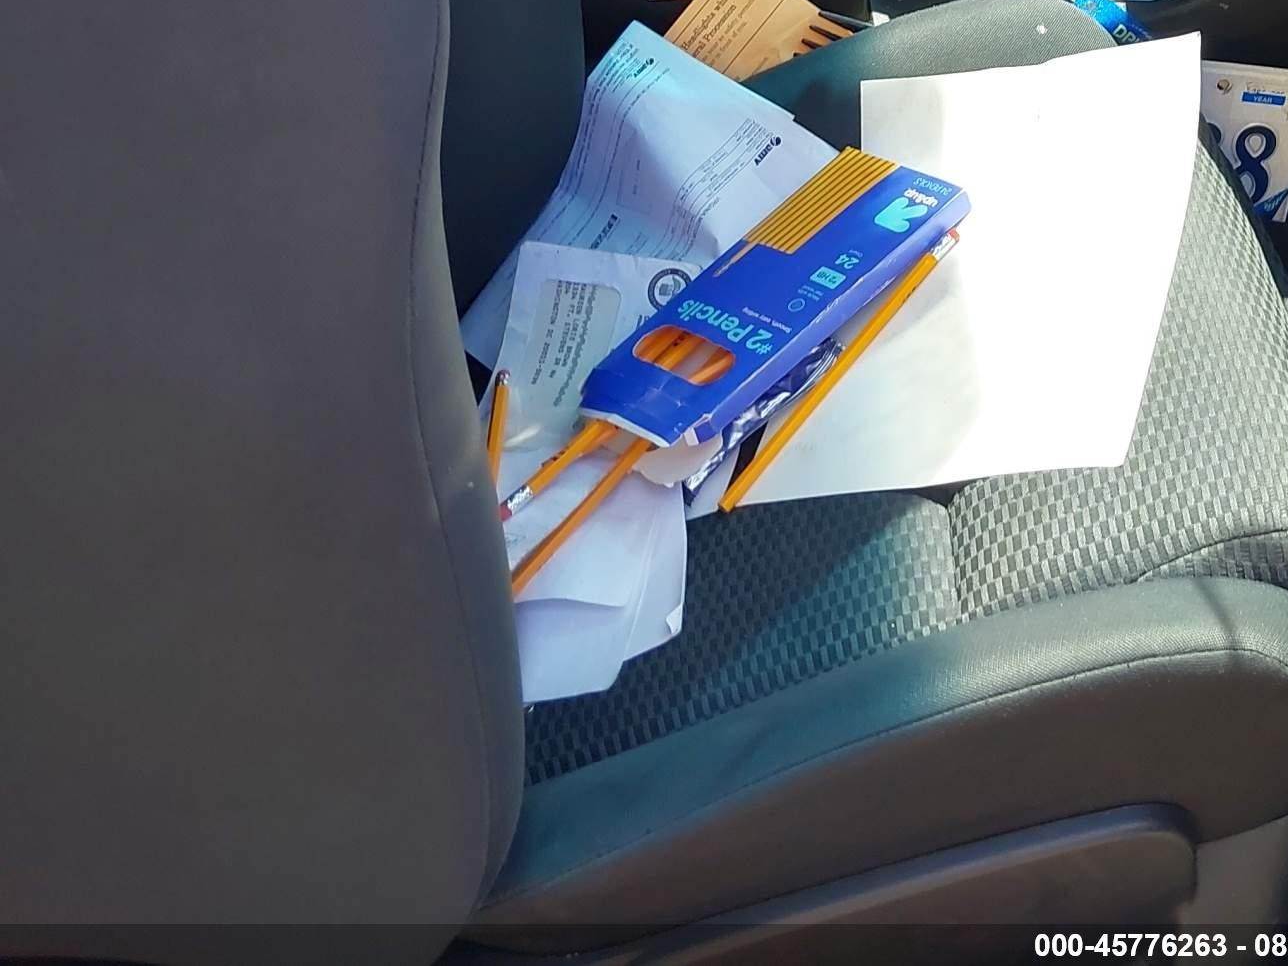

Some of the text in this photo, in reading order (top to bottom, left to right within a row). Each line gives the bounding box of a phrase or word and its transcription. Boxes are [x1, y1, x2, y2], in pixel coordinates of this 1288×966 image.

[1252, 95, 1273, 104] YEAR
[902, 187, 938, 208] up&up
[835, 254, 859, 270] 24
[677, 298, 773, 355] #2 Pencils
